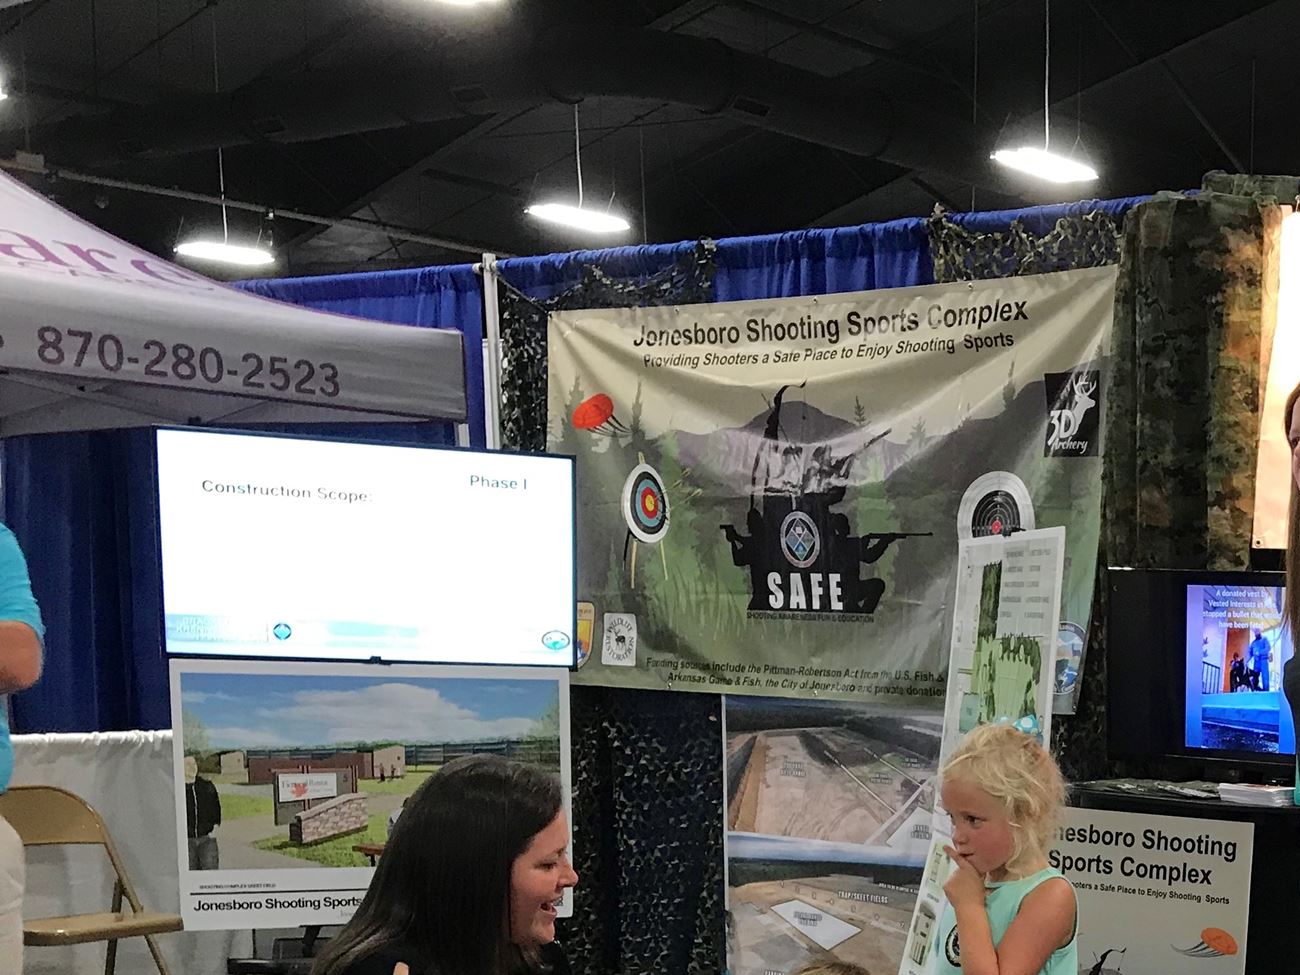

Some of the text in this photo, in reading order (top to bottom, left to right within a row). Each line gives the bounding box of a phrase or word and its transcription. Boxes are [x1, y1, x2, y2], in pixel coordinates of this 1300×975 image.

[633, 299, 1029, 347] Jonesboro Shooting Sports Complex
[37, 326, 340, 398] 870-280-2523
[643, 332, 1014, 369] Providing Shooters a Safe Place to Enjoy Shooting Sports
[1048, 410, 1076, 446] 3D
[1052, 437, 1089, 455] Archery
[202, 479, 311, 500] Construction
[470, 474, 518, 491] Phase
[767, 571, 844, 611] SAFE
[712, 660, 746, 673] include
[747, 662, 761, 674] the
[914, 670, 934, 682] Fish
[765, 678, 779, 688] the
[781, 678, 798, 690] City
[799, 680, 808, 690] of
[1053, 824, 1238, 863] nesboro Shooting
[1048, 849, 1213, 886] Sports Complex
[193, 896, 364, 912] Jonesboro Shooting Sports
[1071, 881, 1092, 891] ooters
[1099, 883, 1116, 892] Safe
[1116, 885, 1136, 895] Place
[1137, 887, 1146, 896] to
[1147, 888, 1167, 899] Enjoy
[1168, 890, 1202, 904] Shooting
[1204, 895, 1230, 905] Sports
